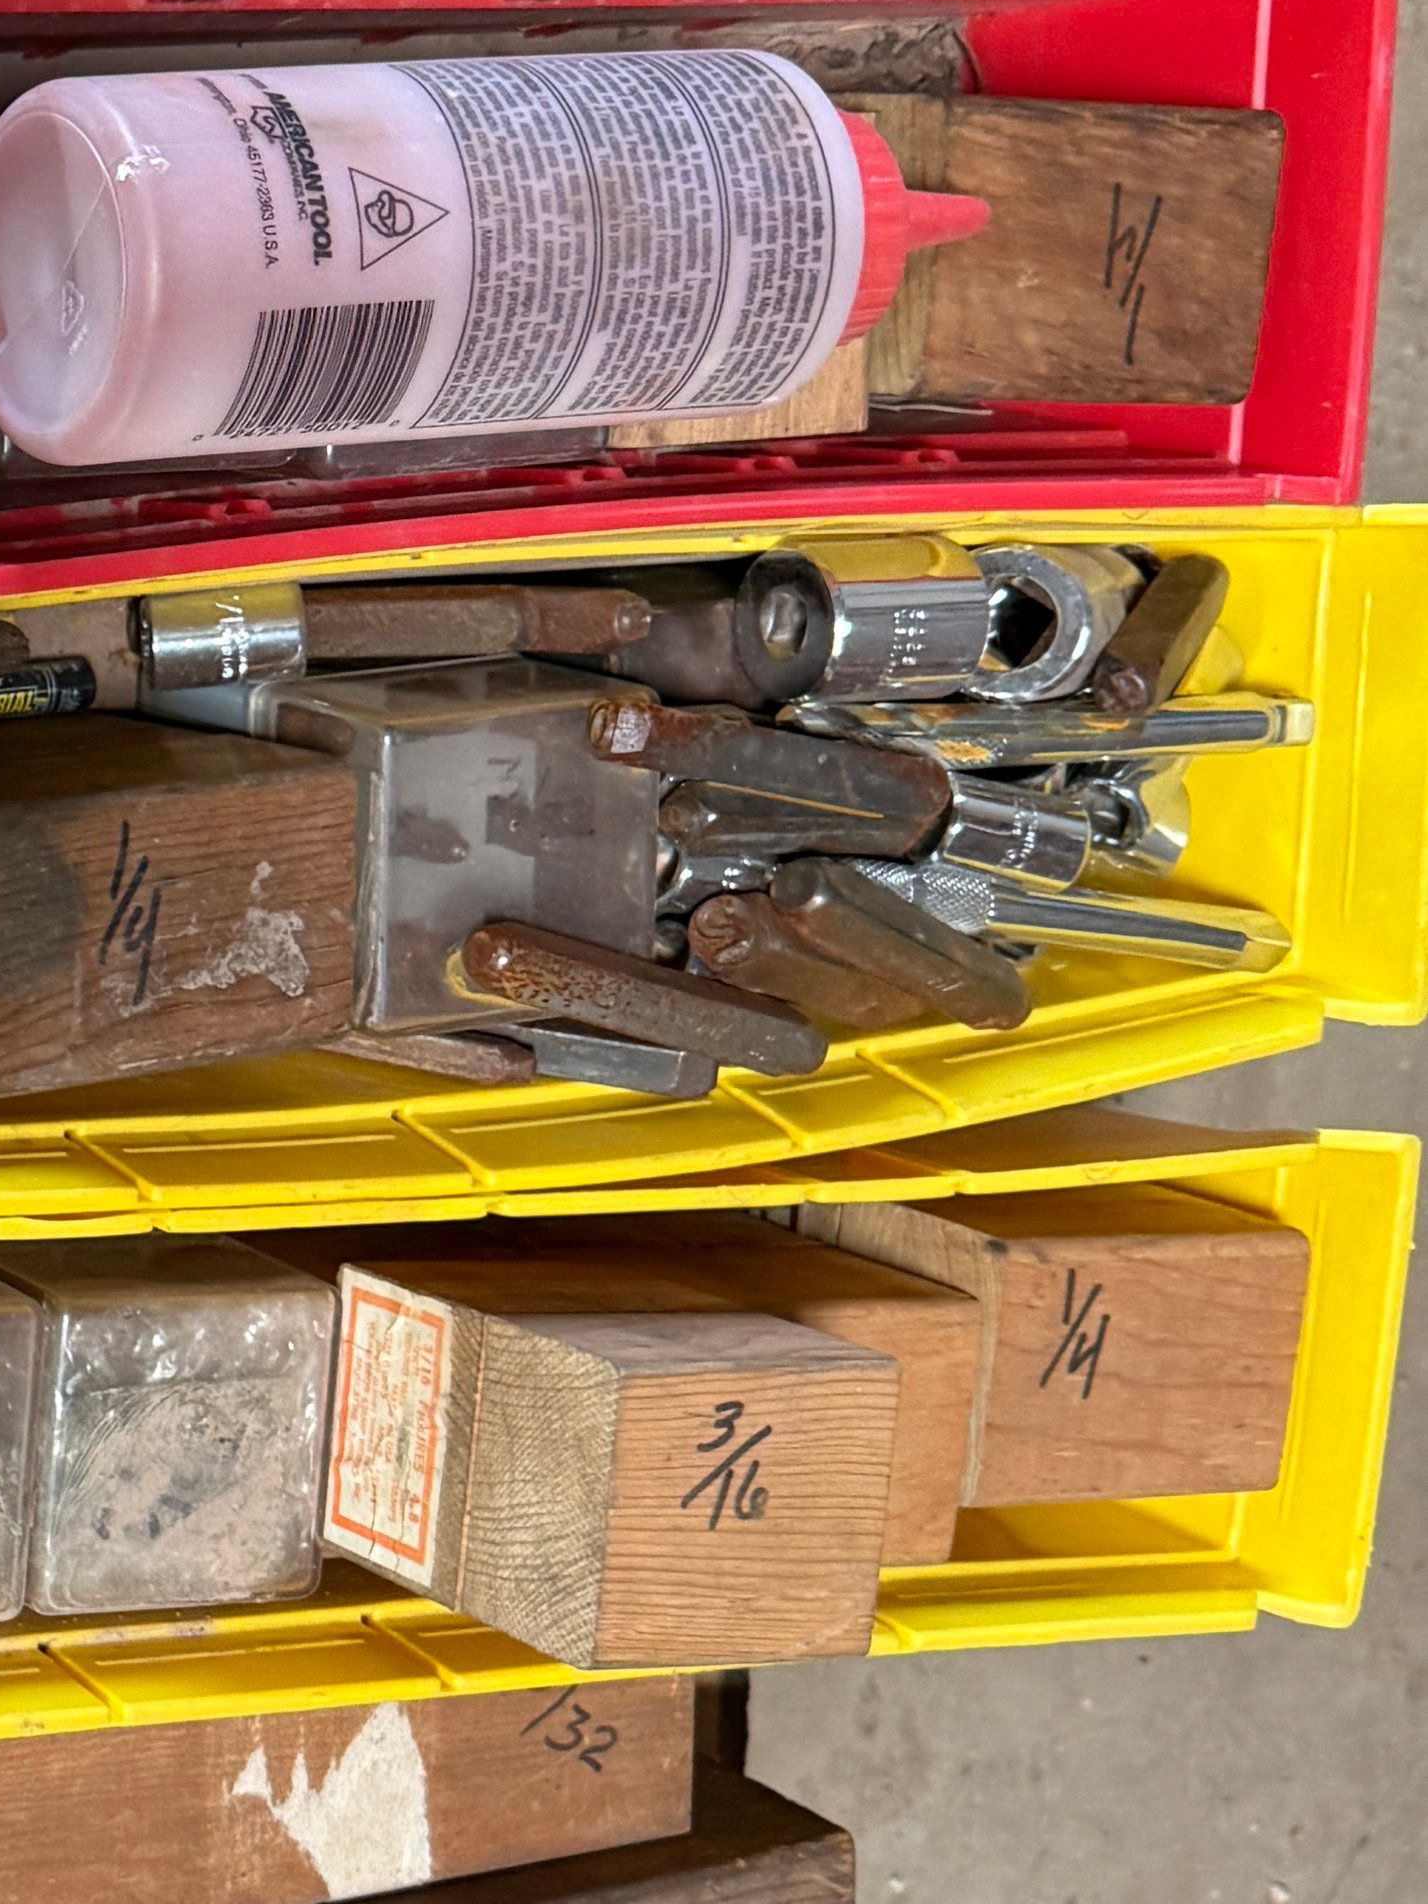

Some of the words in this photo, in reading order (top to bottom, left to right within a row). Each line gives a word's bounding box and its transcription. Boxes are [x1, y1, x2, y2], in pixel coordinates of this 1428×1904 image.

[1103, 181, 1164, 366] 1/4
[99, 819, 162, 1005] 1/4
[1039, 1269, 1111, 1400] 1/4
[680, 1401, 772, 1531] 3/16
